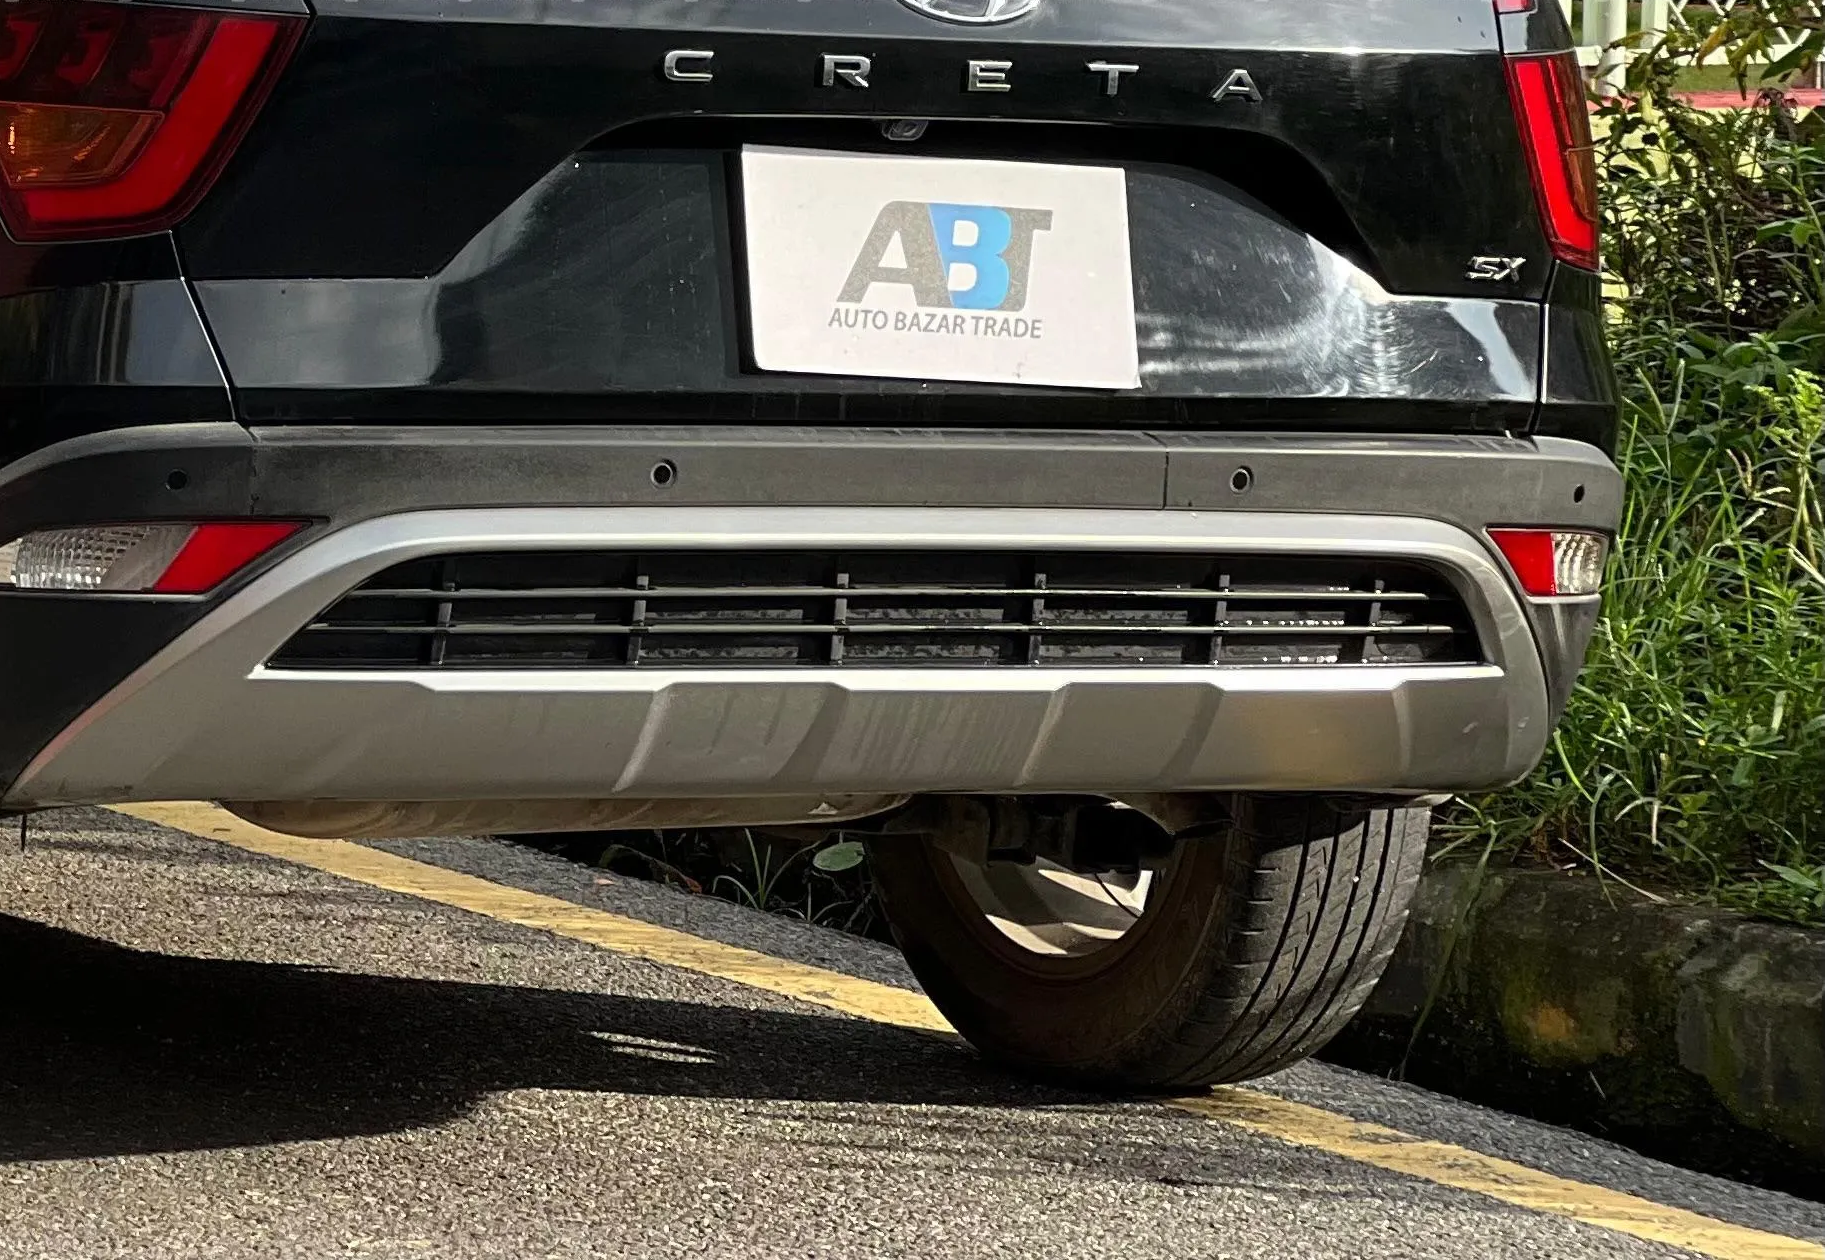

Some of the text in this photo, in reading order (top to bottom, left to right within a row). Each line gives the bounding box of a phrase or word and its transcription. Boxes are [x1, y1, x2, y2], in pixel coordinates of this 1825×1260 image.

[664, 50, 1264, 103] CRETA
[836, 200, 1053, 312] ABT
[1467, 256, 1526, 282] SX
[828, 307, 1043, 339] AUTO BAZAR TRADE
